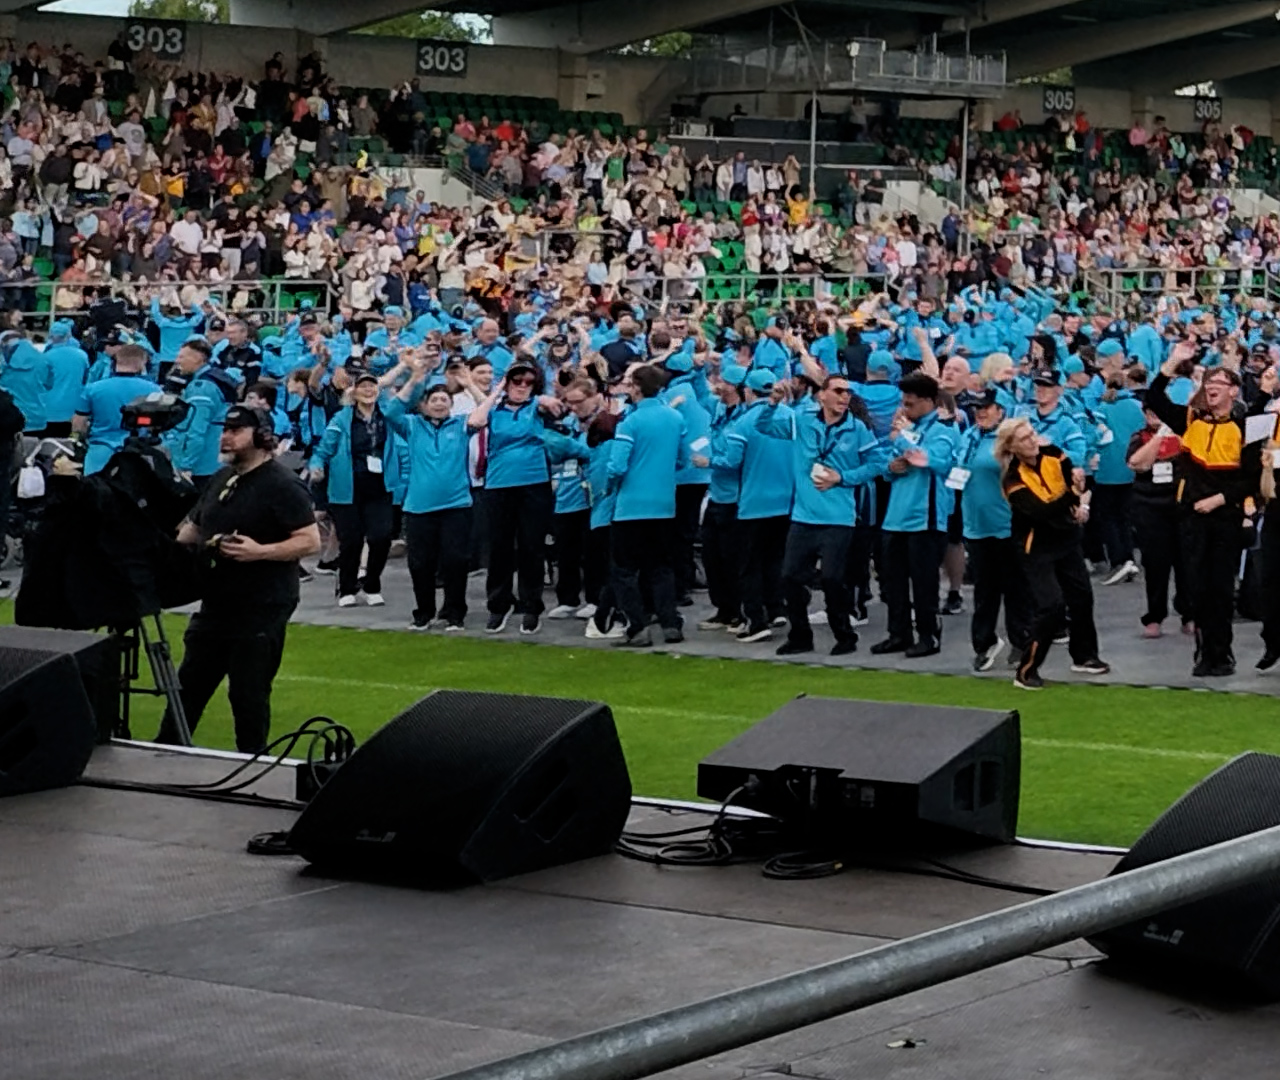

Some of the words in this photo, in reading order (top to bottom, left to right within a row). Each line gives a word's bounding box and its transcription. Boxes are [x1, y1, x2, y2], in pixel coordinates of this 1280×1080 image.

[127, 24, 183, 54] 303
[419, 45, 465, 72] 303
[1044, 89, 1074, 110] 305
[1195, 100, 1222, 119] 305
